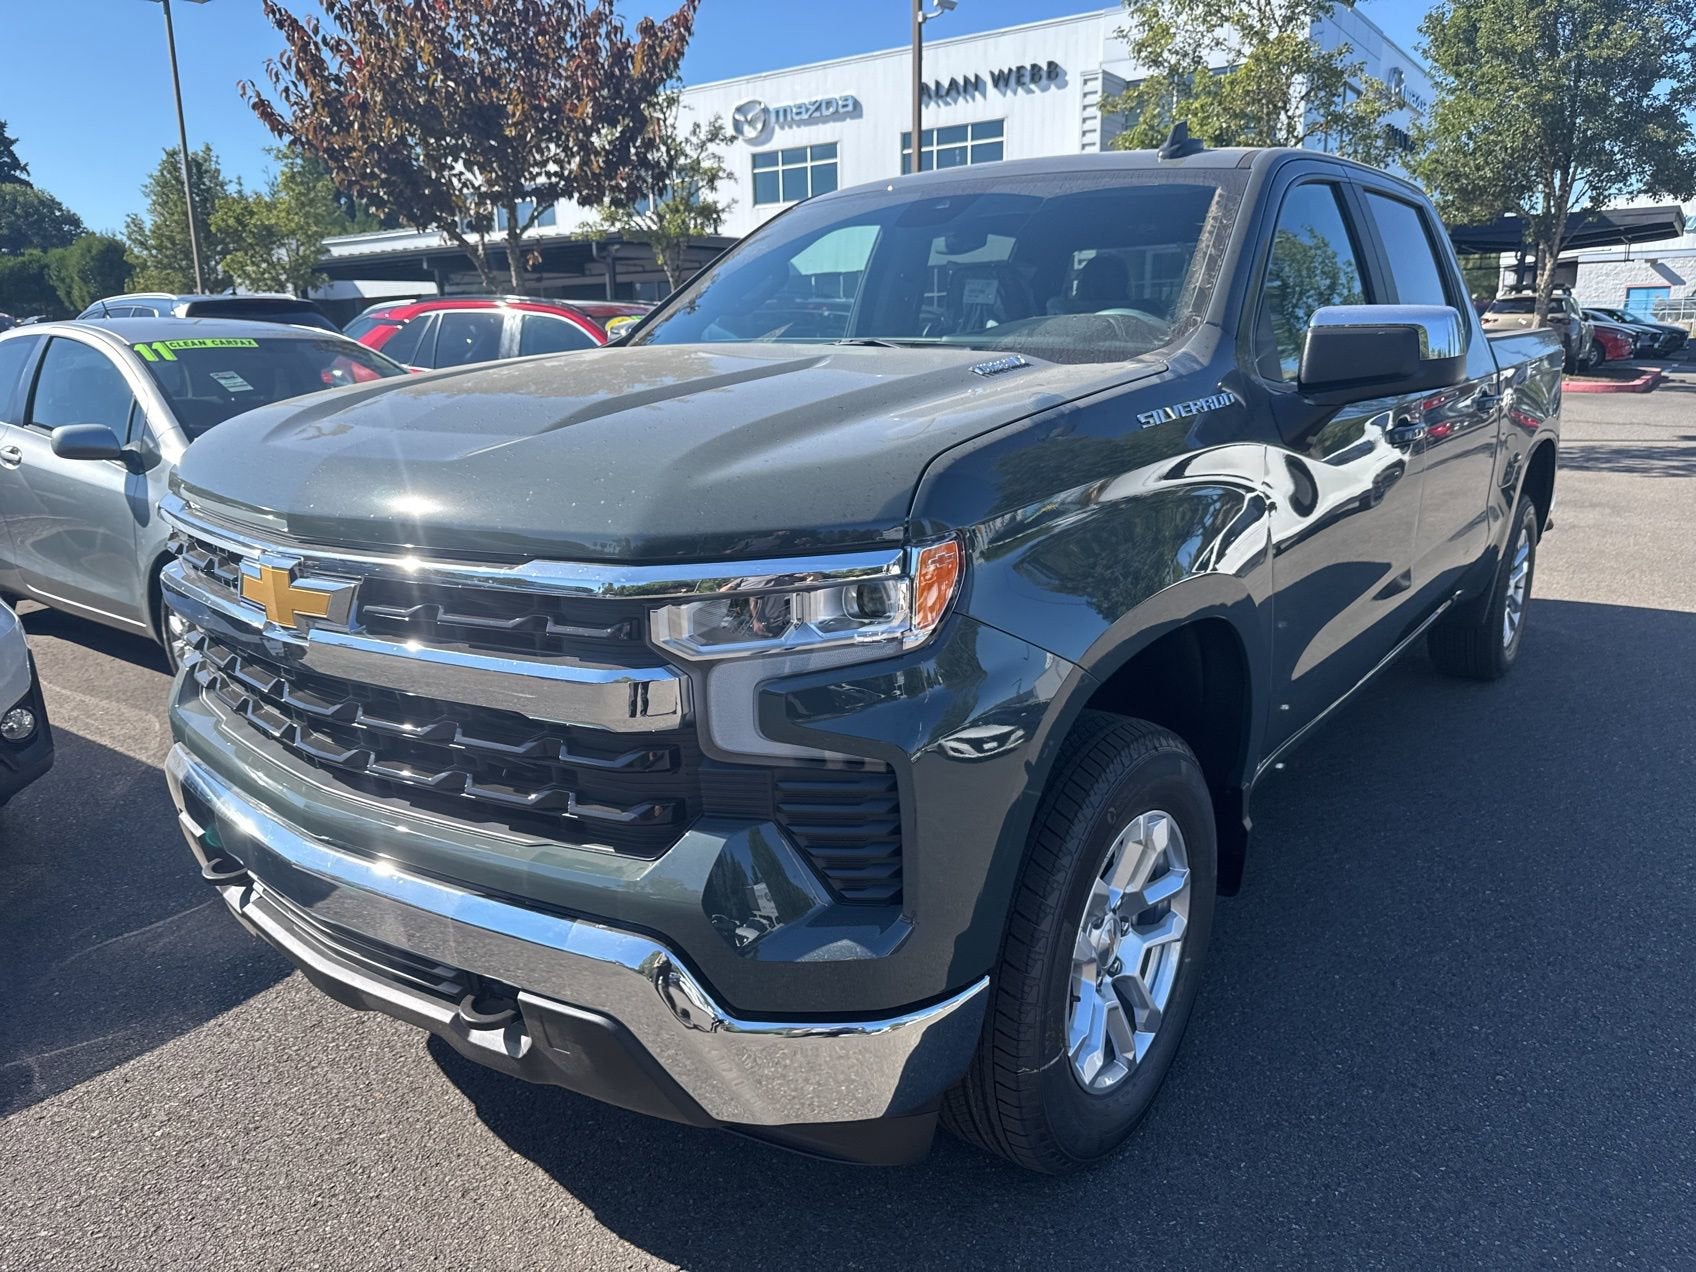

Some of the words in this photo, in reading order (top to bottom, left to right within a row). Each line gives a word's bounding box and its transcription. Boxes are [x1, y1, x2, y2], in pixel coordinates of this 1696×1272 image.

[989, 60, 1060, 90] WEBB
[134, 342, 178, 361] 11
[169, 339, 207, 349] CLEAN
[212, 338, 256, 347] CARFAX
[1136, 392, 1235, 429] SILVERADO
